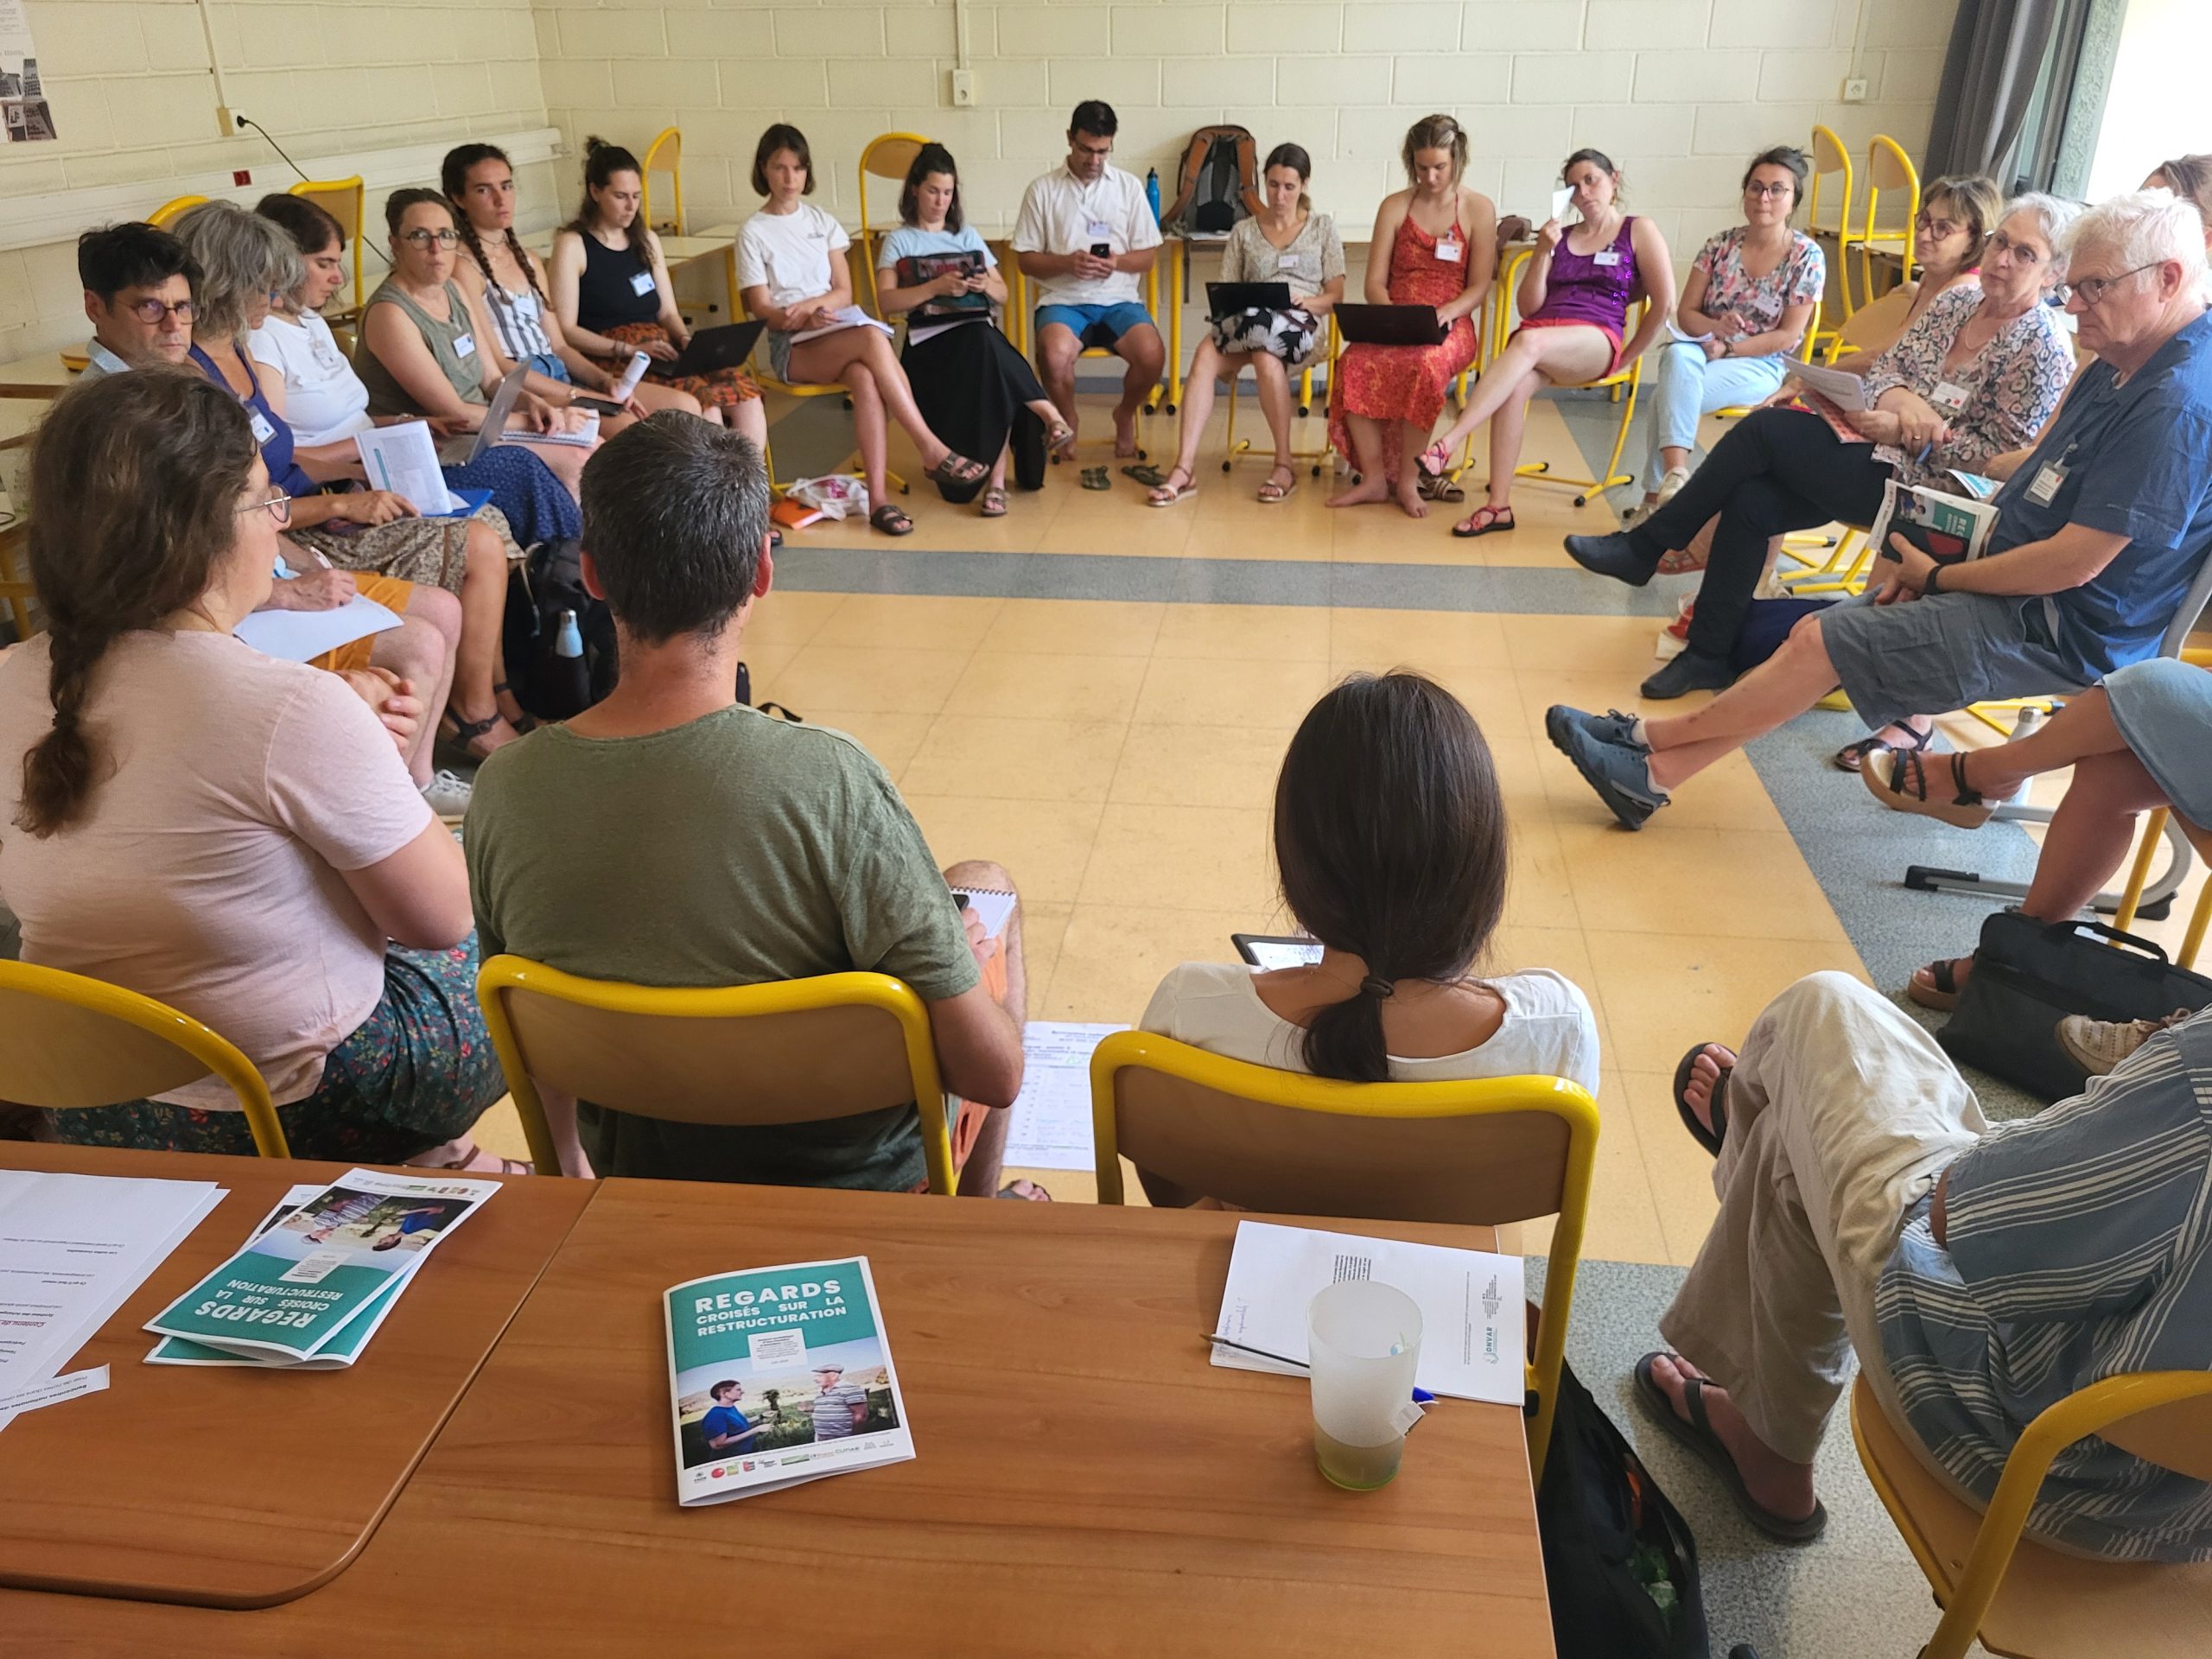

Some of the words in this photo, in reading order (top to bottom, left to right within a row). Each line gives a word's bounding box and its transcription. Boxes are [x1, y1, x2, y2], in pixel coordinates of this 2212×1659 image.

[214, 1289, 234, 1300] LA
[226, 1279, 344, 1300] RESTRUCTURATION
[241, 1294, 269, 1306] SUR
[695, 1279, 842, 1313] REGARDS
[194, 1300, 318, 1328] REGARDS
[276, 1299, 330, 1311] CROISÉS
[696, 1306, 760, 1325] CROISÉS
[779, 1300, 808, 1312] SUR
[825, 1295, 845, 1306] LA
[697, 1306, 847, 1337] RESTRUCTURATION
